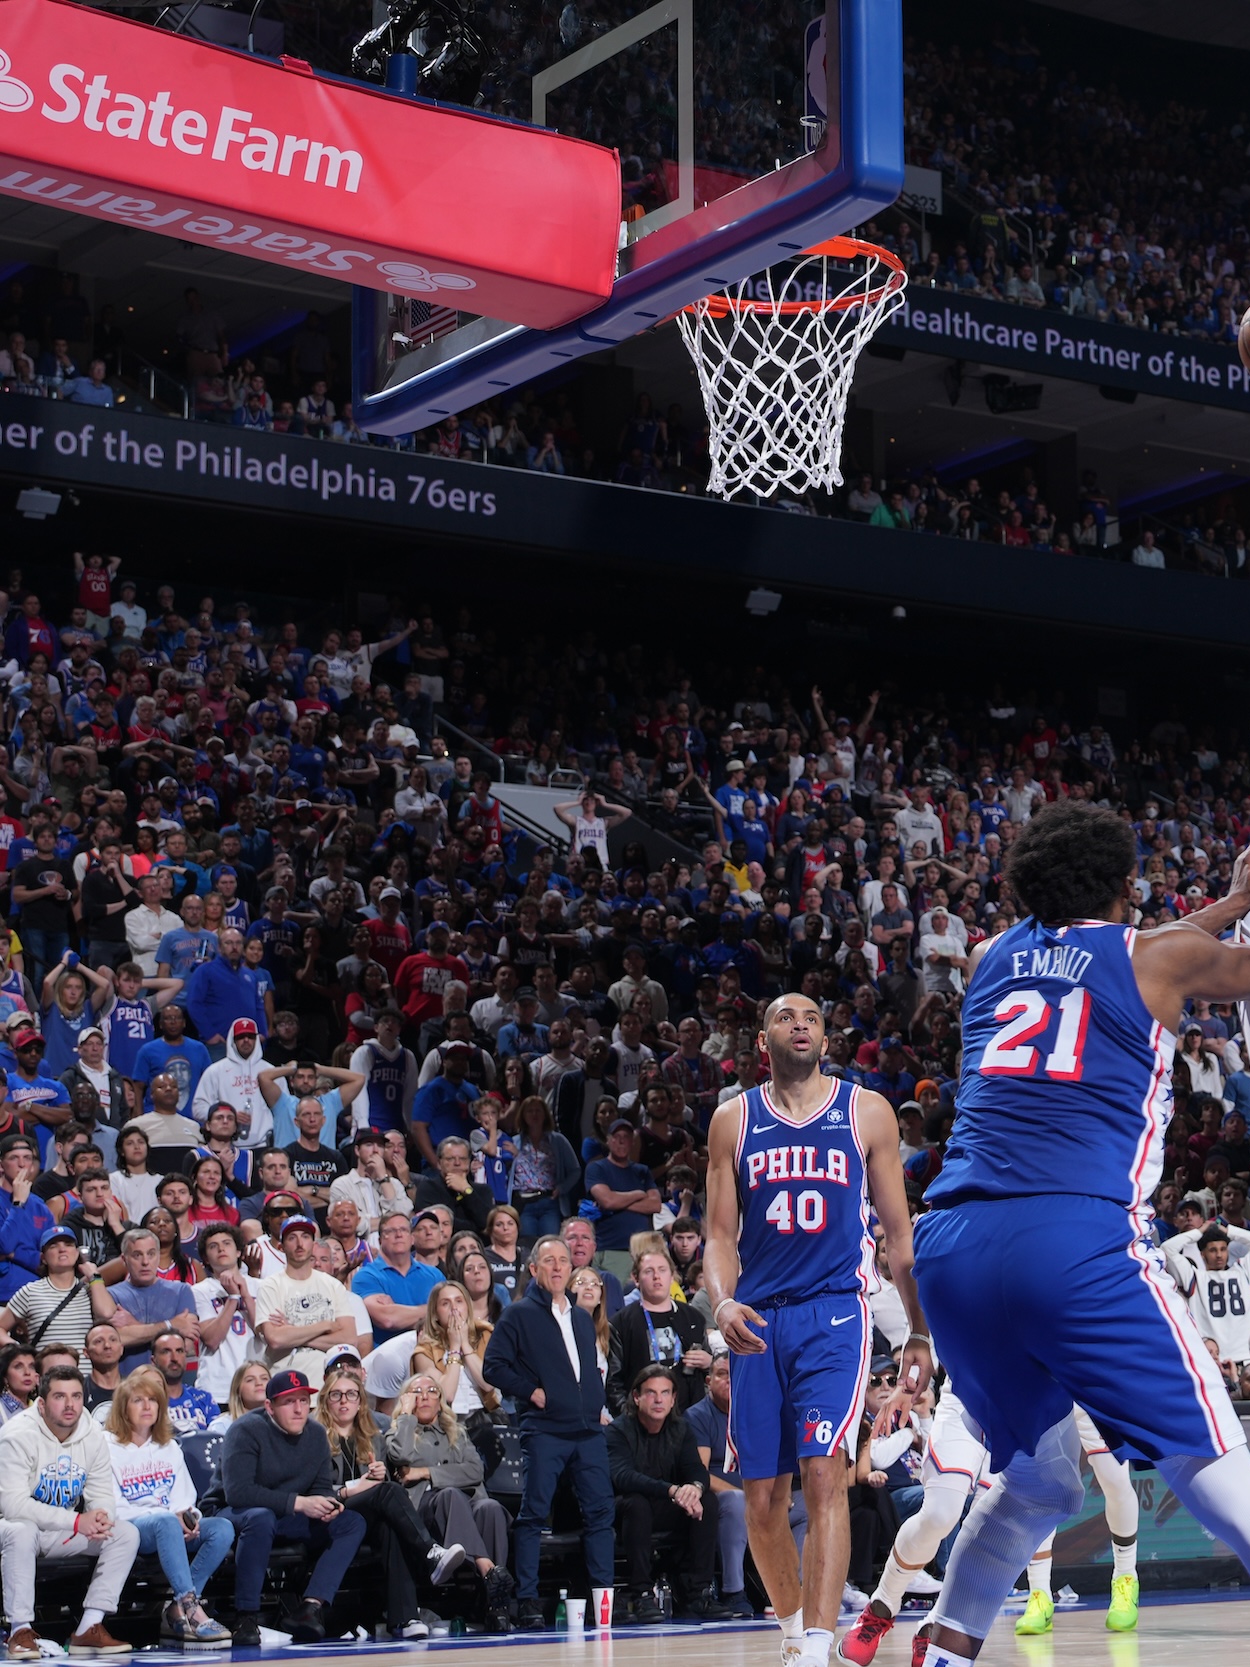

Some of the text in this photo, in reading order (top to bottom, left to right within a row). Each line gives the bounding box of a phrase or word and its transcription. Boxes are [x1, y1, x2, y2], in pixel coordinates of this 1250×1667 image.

[892, 299, 1039, 352] Healthcare
[1045, 330, 1140, 375] Partner
[1148, 352, 1174, 377] of
[1179, 355, 1221, 386] the
[54, 424, 95, 457] of
[103, 430, 164, 468] the
[175, 439, 397, 502] Philadelphia
[407, 475, 497, 516] 76ers
[1011, 944, 1094, 984] EMBIID
[127, 1021, 146, 1039] 21
[979, 987, 1092, 1082] 21
[385, 1084, 397, 1101] 0
[746, 1145, 849, 1190] PHILA
[766, 1189, 827, 1234] 40
[1207, 1279, 1246, 1318] 88
[231, 1316, 246, 1336] 0
[288, 1372, 300, 1386] 76
[802, 1419, 833, 1445] 76
